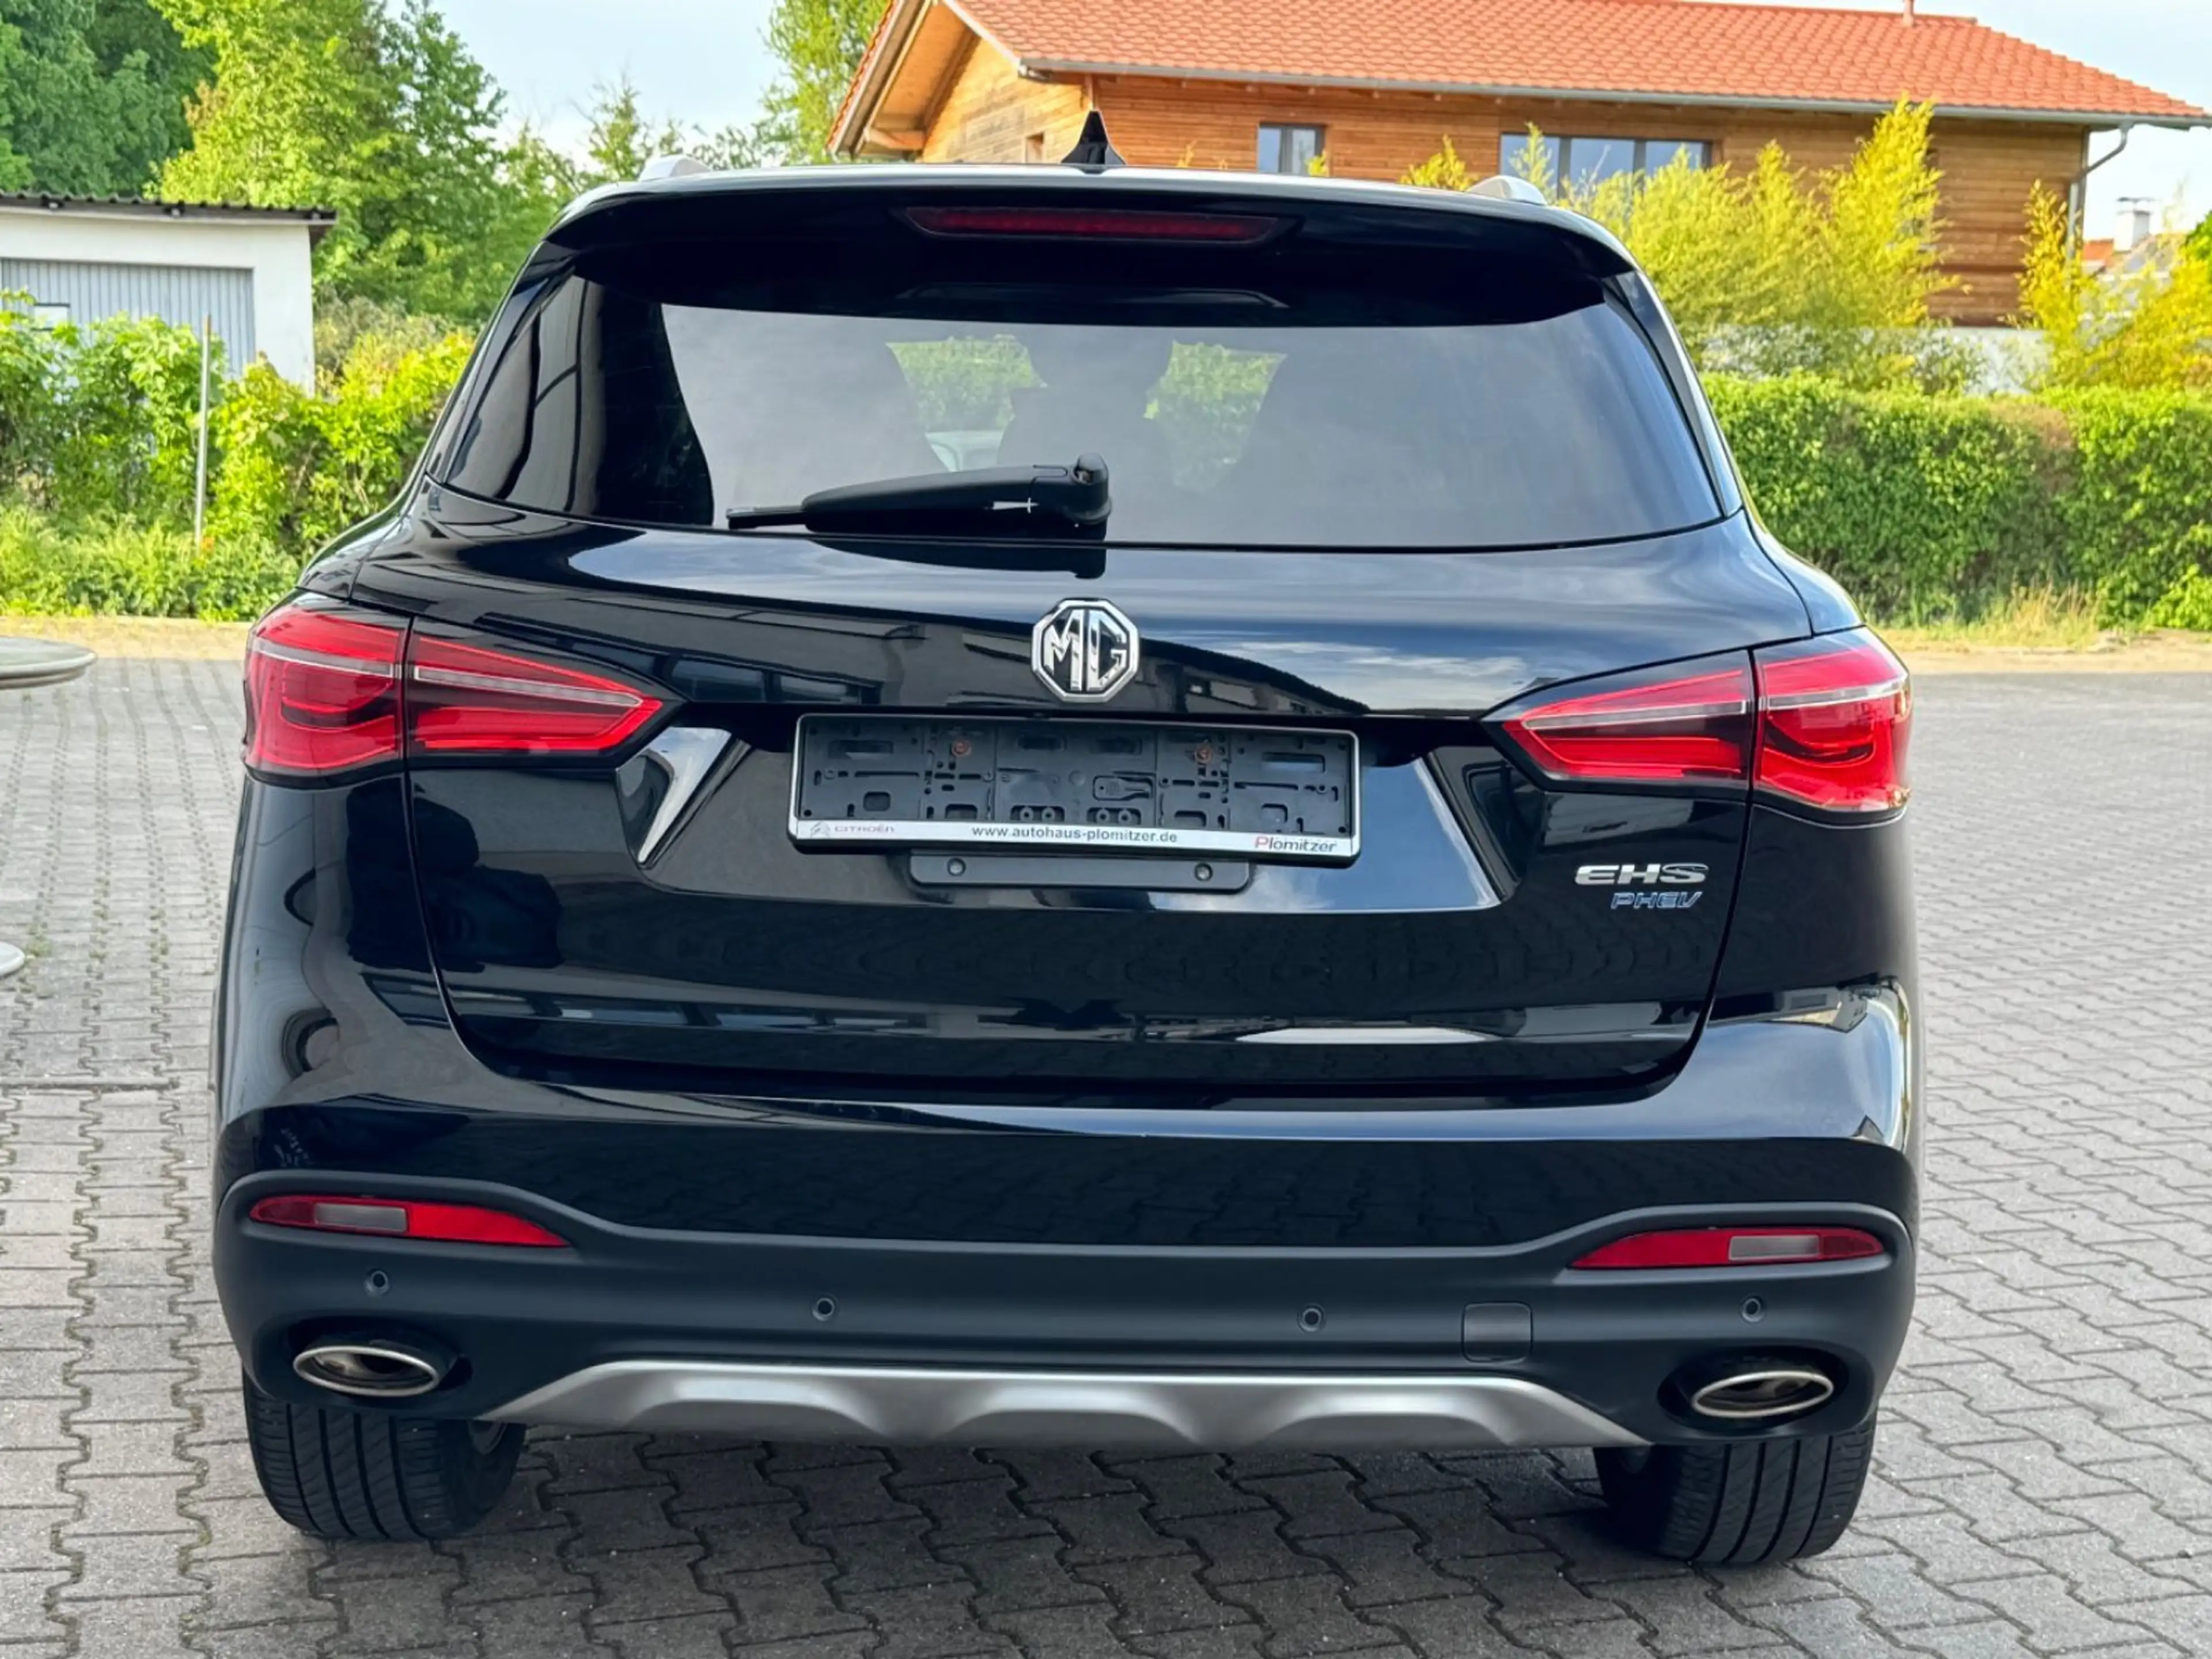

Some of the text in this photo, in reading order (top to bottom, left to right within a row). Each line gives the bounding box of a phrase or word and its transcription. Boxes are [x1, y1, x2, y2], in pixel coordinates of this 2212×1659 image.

[1044, 608, 1127, 692] MG
[971, 825, 1177, 843] www.autohaus-plomitzer.de
[1255, 836, 1337, 853] Plomitzer
[1575, 863, 1709, 885] EHS
[1611, 891, 1703, 910] PHEV
